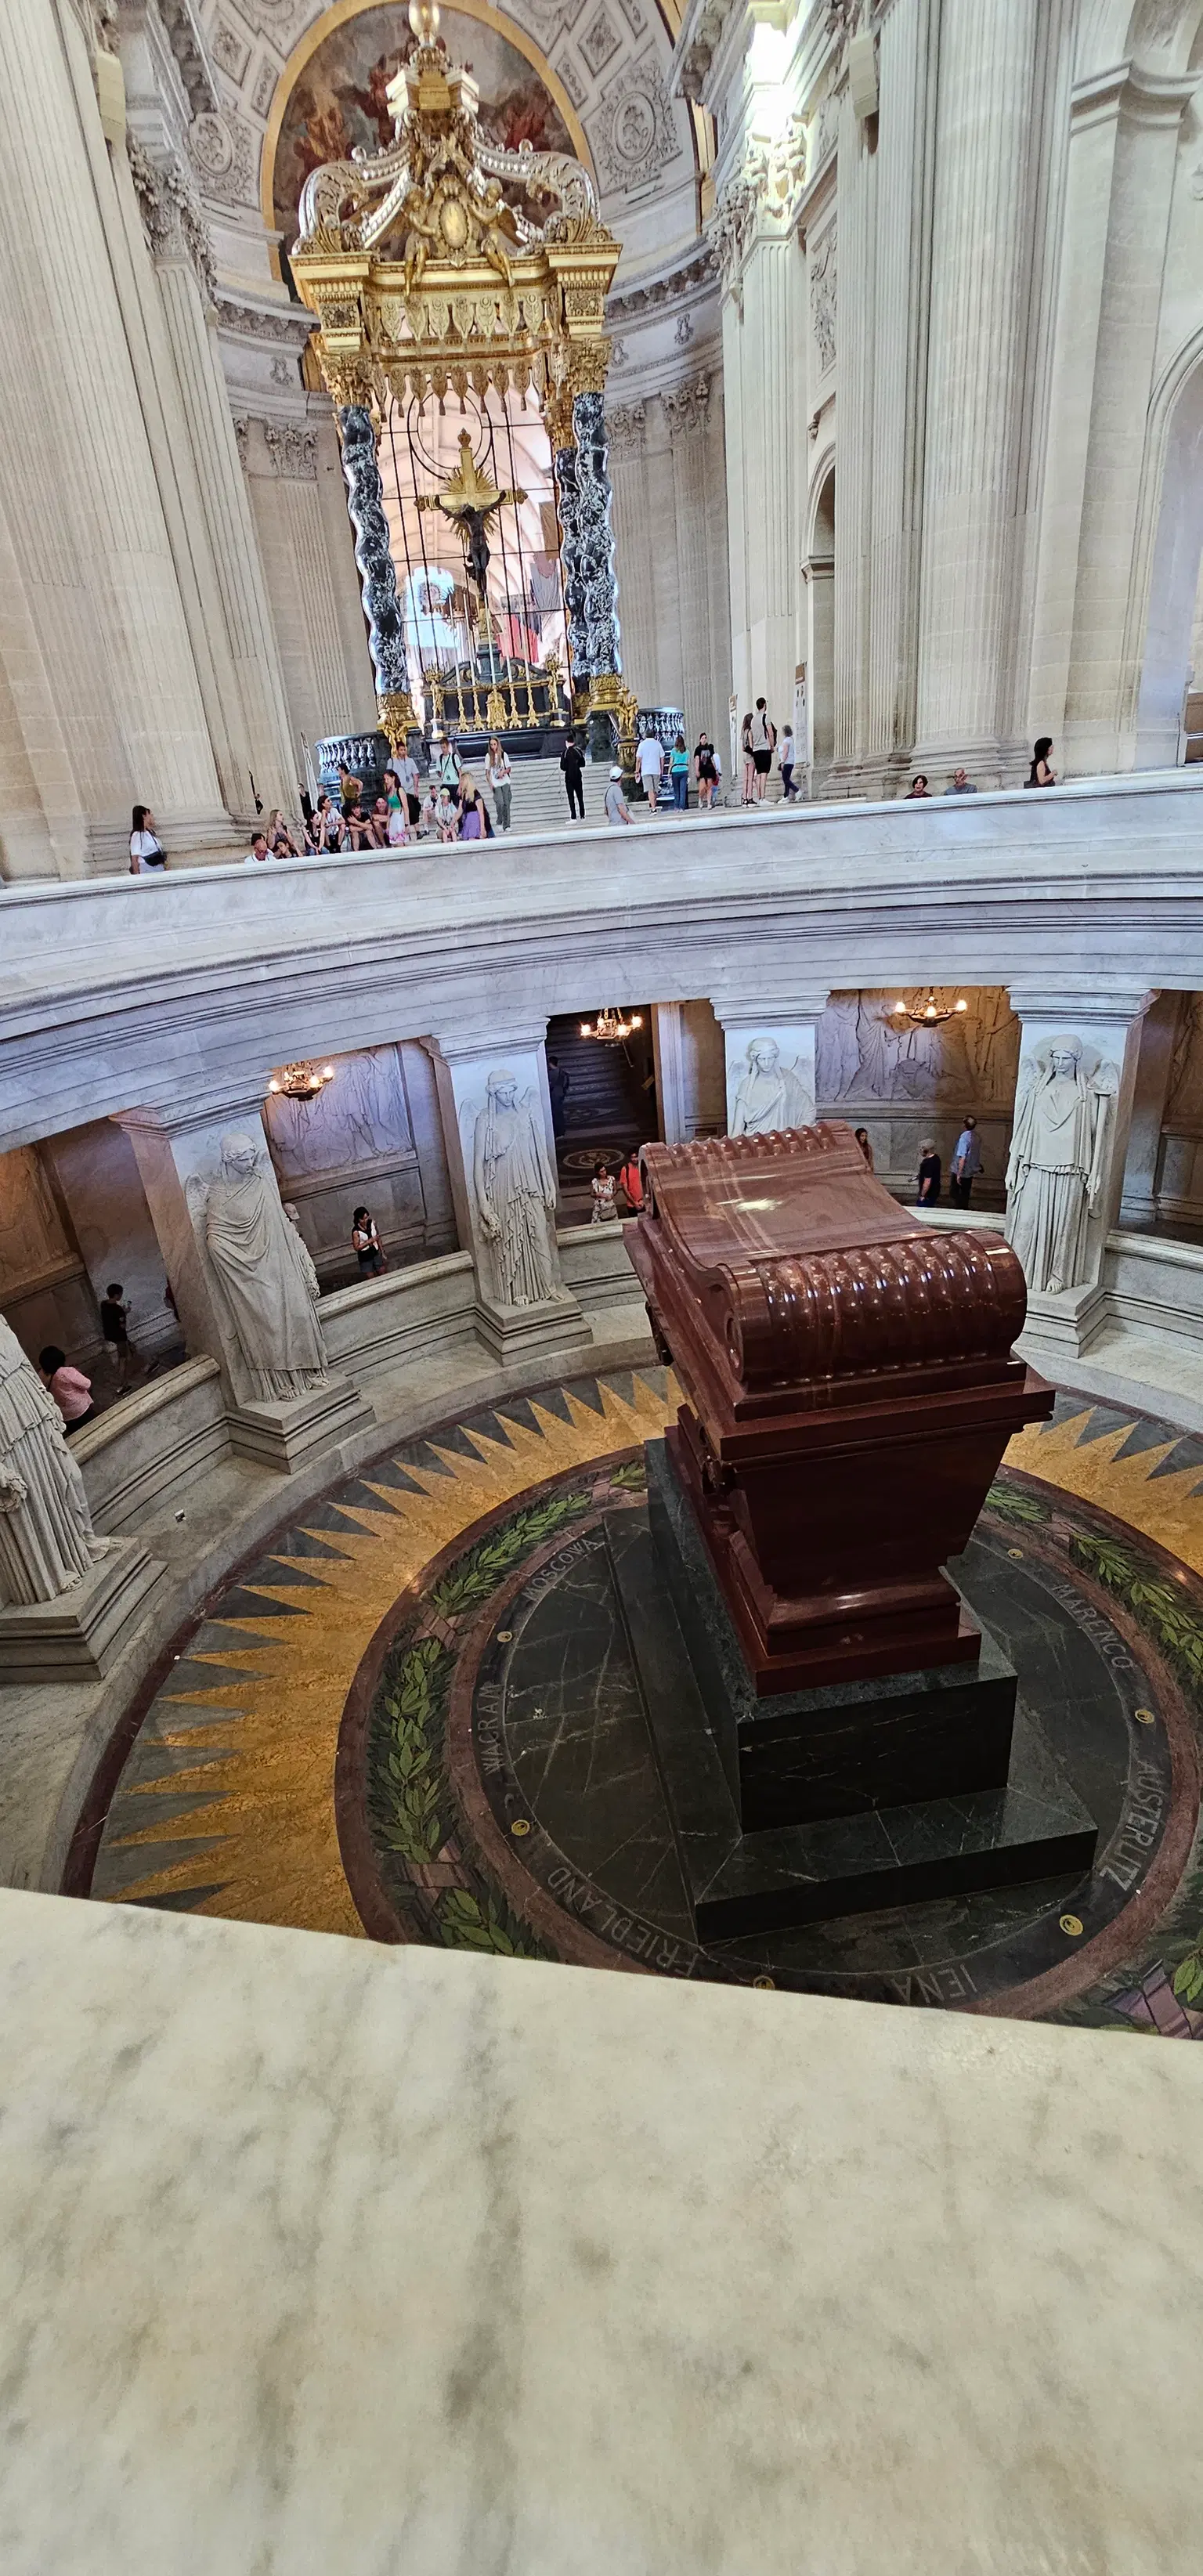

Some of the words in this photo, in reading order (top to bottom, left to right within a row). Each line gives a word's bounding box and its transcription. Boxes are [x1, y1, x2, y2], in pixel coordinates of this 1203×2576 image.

[522, 1538, 599, 1602] MOSCOWA
[1099, 1760, 1165, 1891] AUSTERLITZ
[548, 1866, 699, 1977] FRIEDLAND
[889, 1964, 978, 2005] IENA
